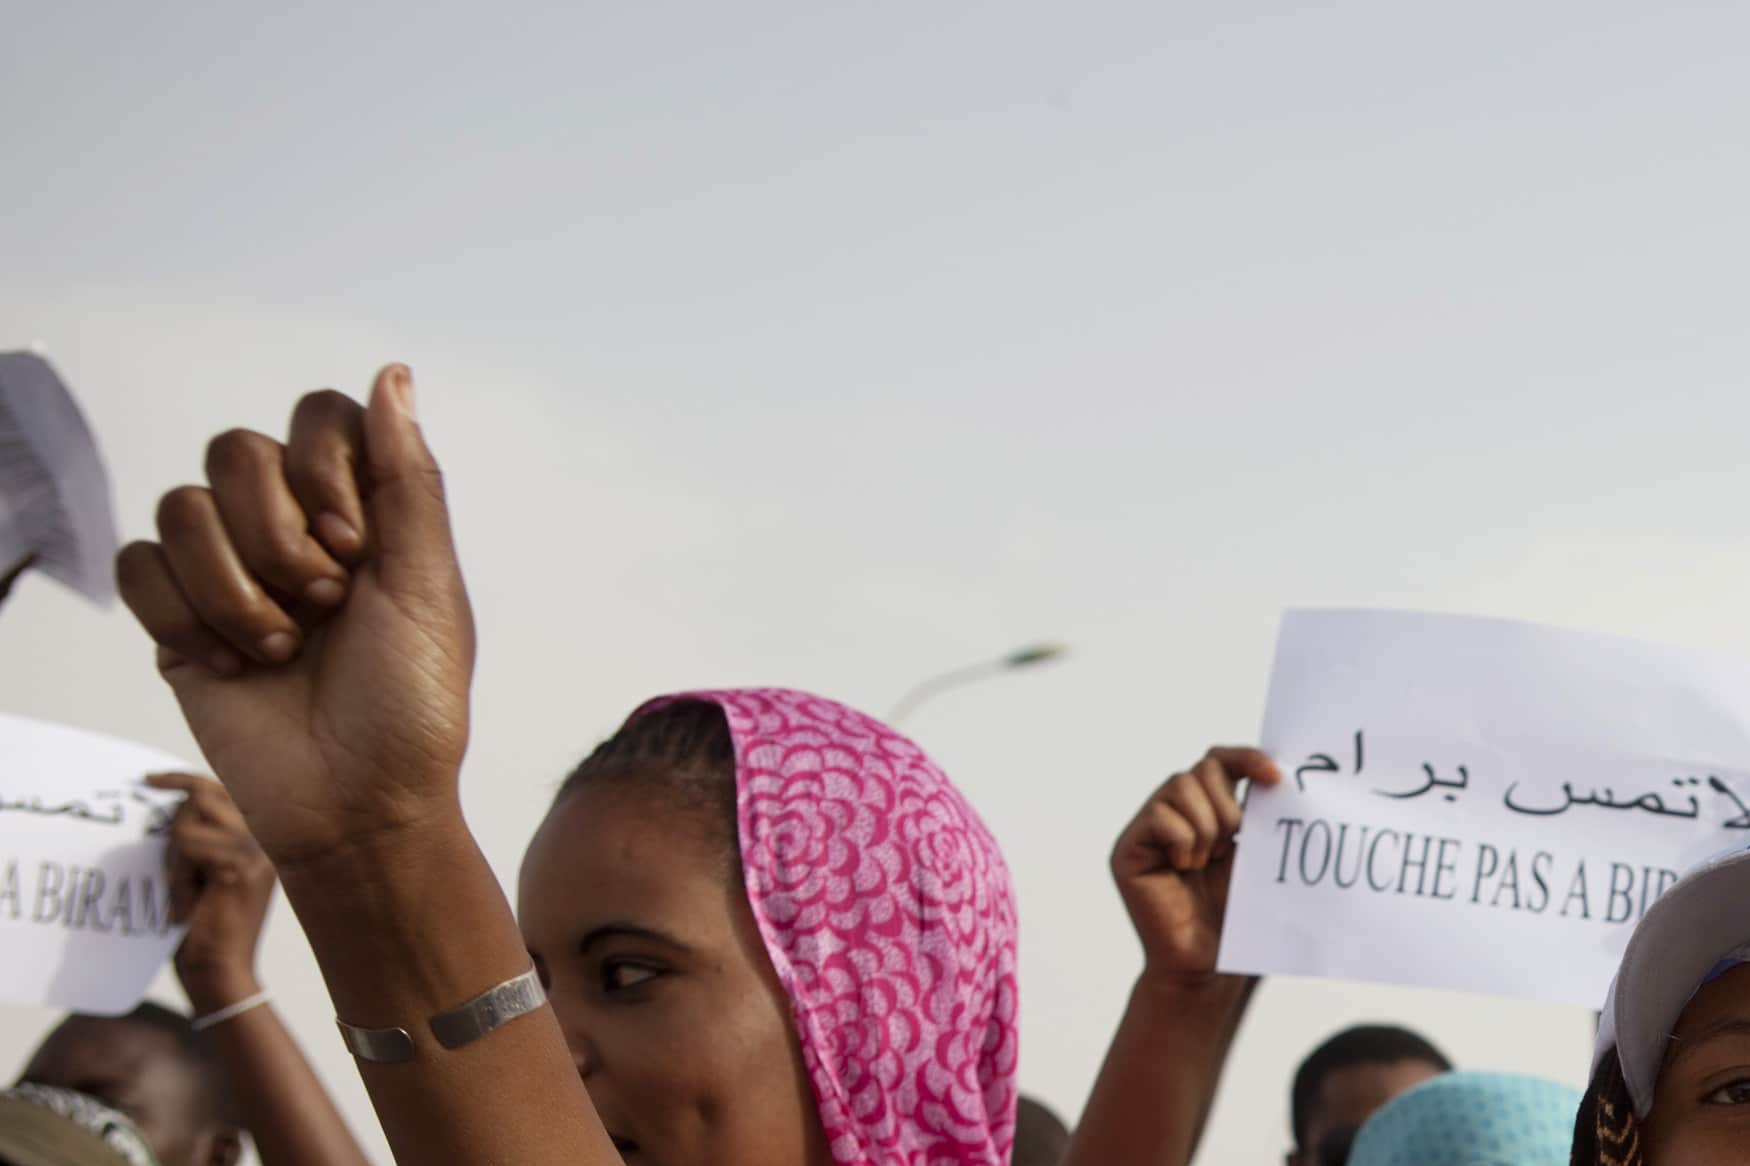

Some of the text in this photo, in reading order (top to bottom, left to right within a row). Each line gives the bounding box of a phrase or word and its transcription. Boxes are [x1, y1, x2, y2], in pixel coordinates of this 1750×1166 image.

[1275, 817, 1462, 901] TOUCHE
[1469, 843, 1554, 914] PAS
[1559, 858, 1591, 920] A
